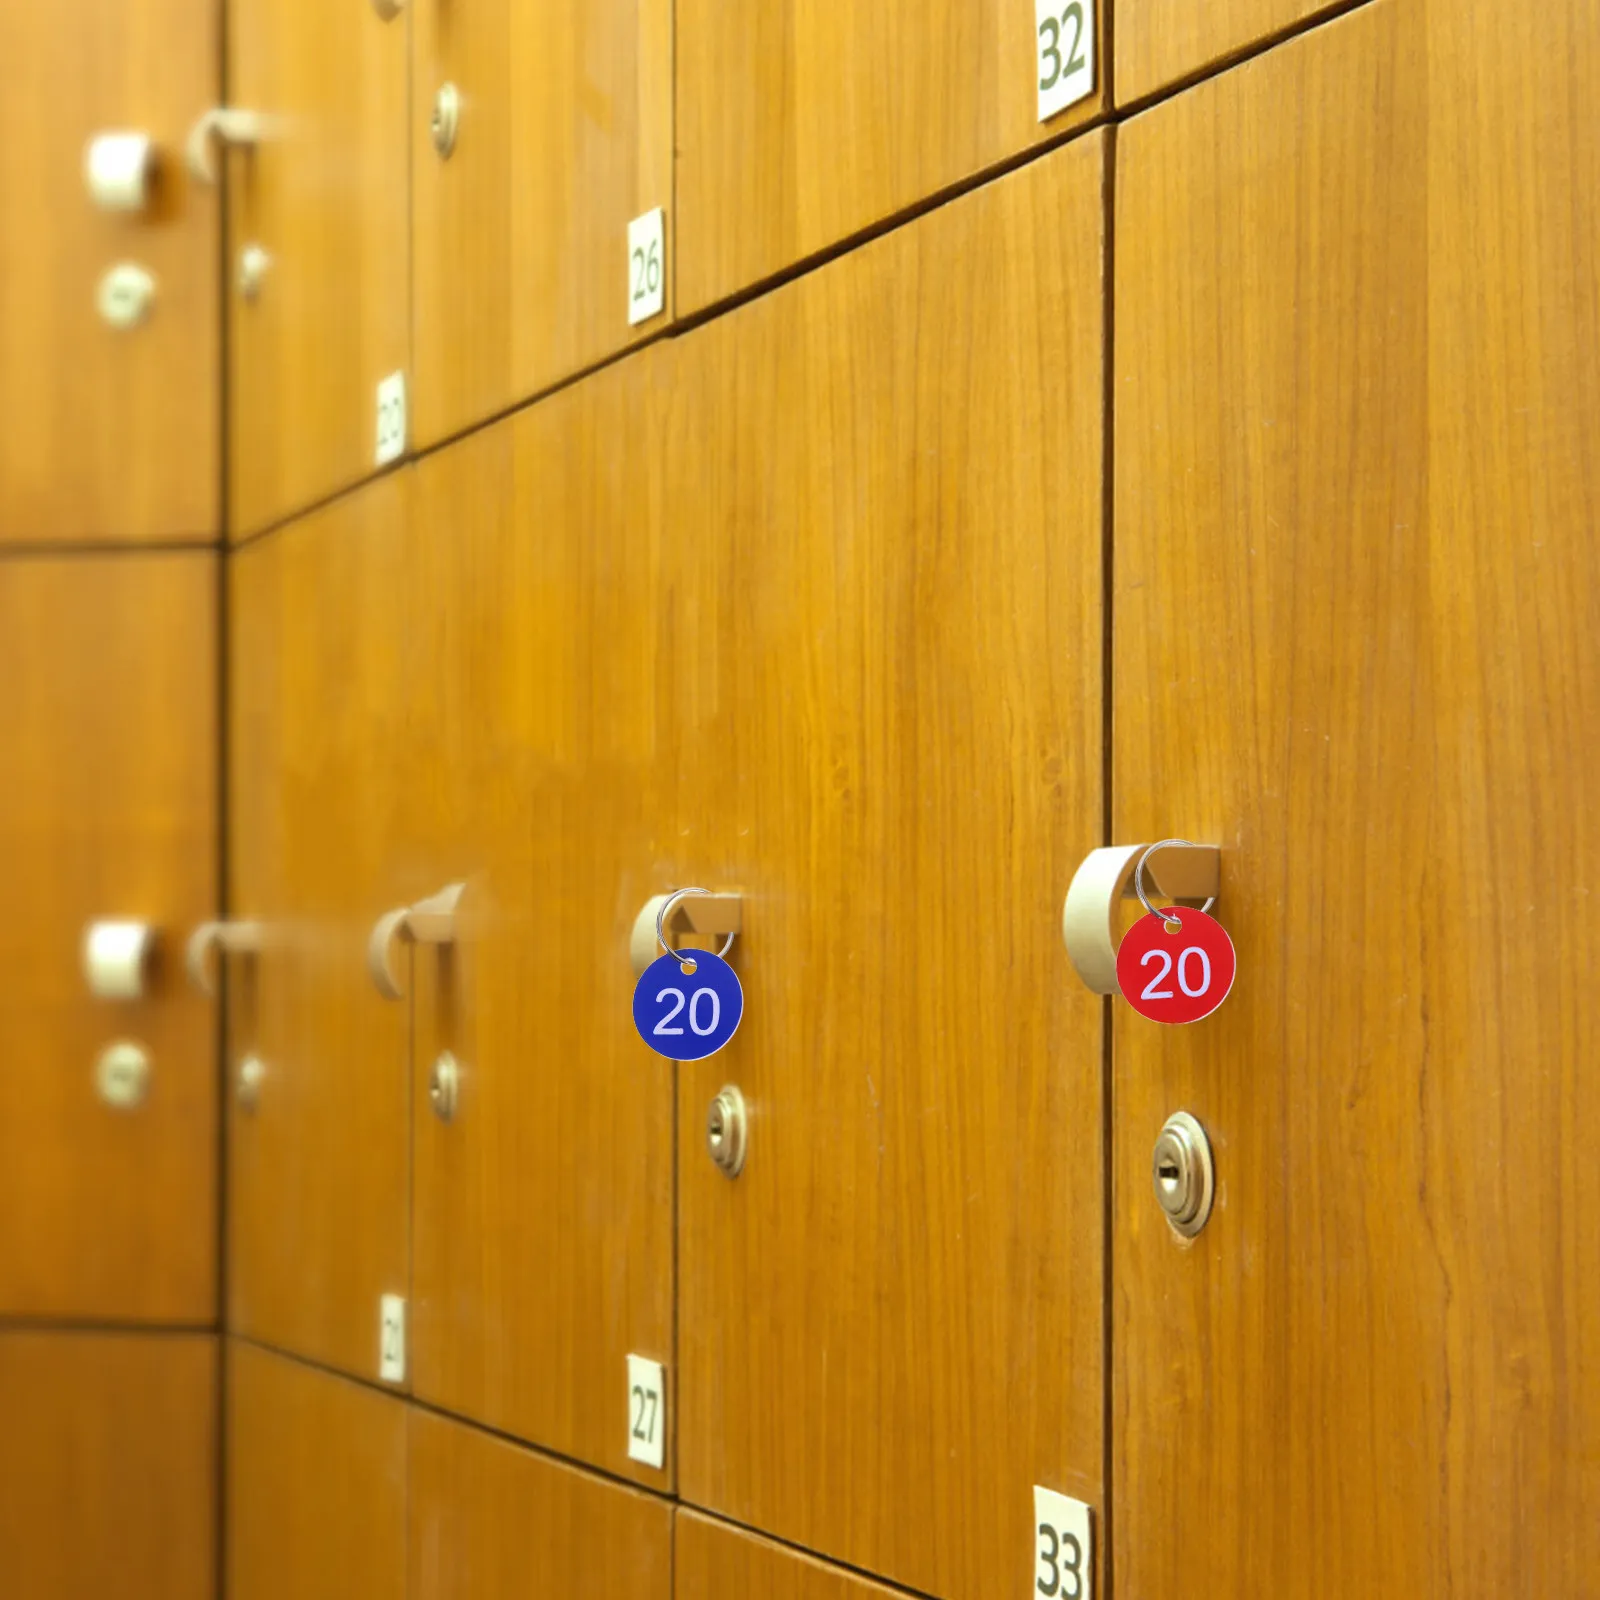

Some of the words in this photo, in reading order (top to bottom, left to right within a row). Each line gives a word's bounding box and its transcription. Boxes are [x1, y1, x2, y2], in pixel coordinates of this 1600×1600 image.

[1038, 1, 1085, 91] 32
[632, 238, 659, 301] 26
[1140, 946, 1211, 1000] 20
[653, 987, 720, 1035] 20
[631, 1384, 657, 1444] 27
[1036, 1523, 1083, 1600] 33
